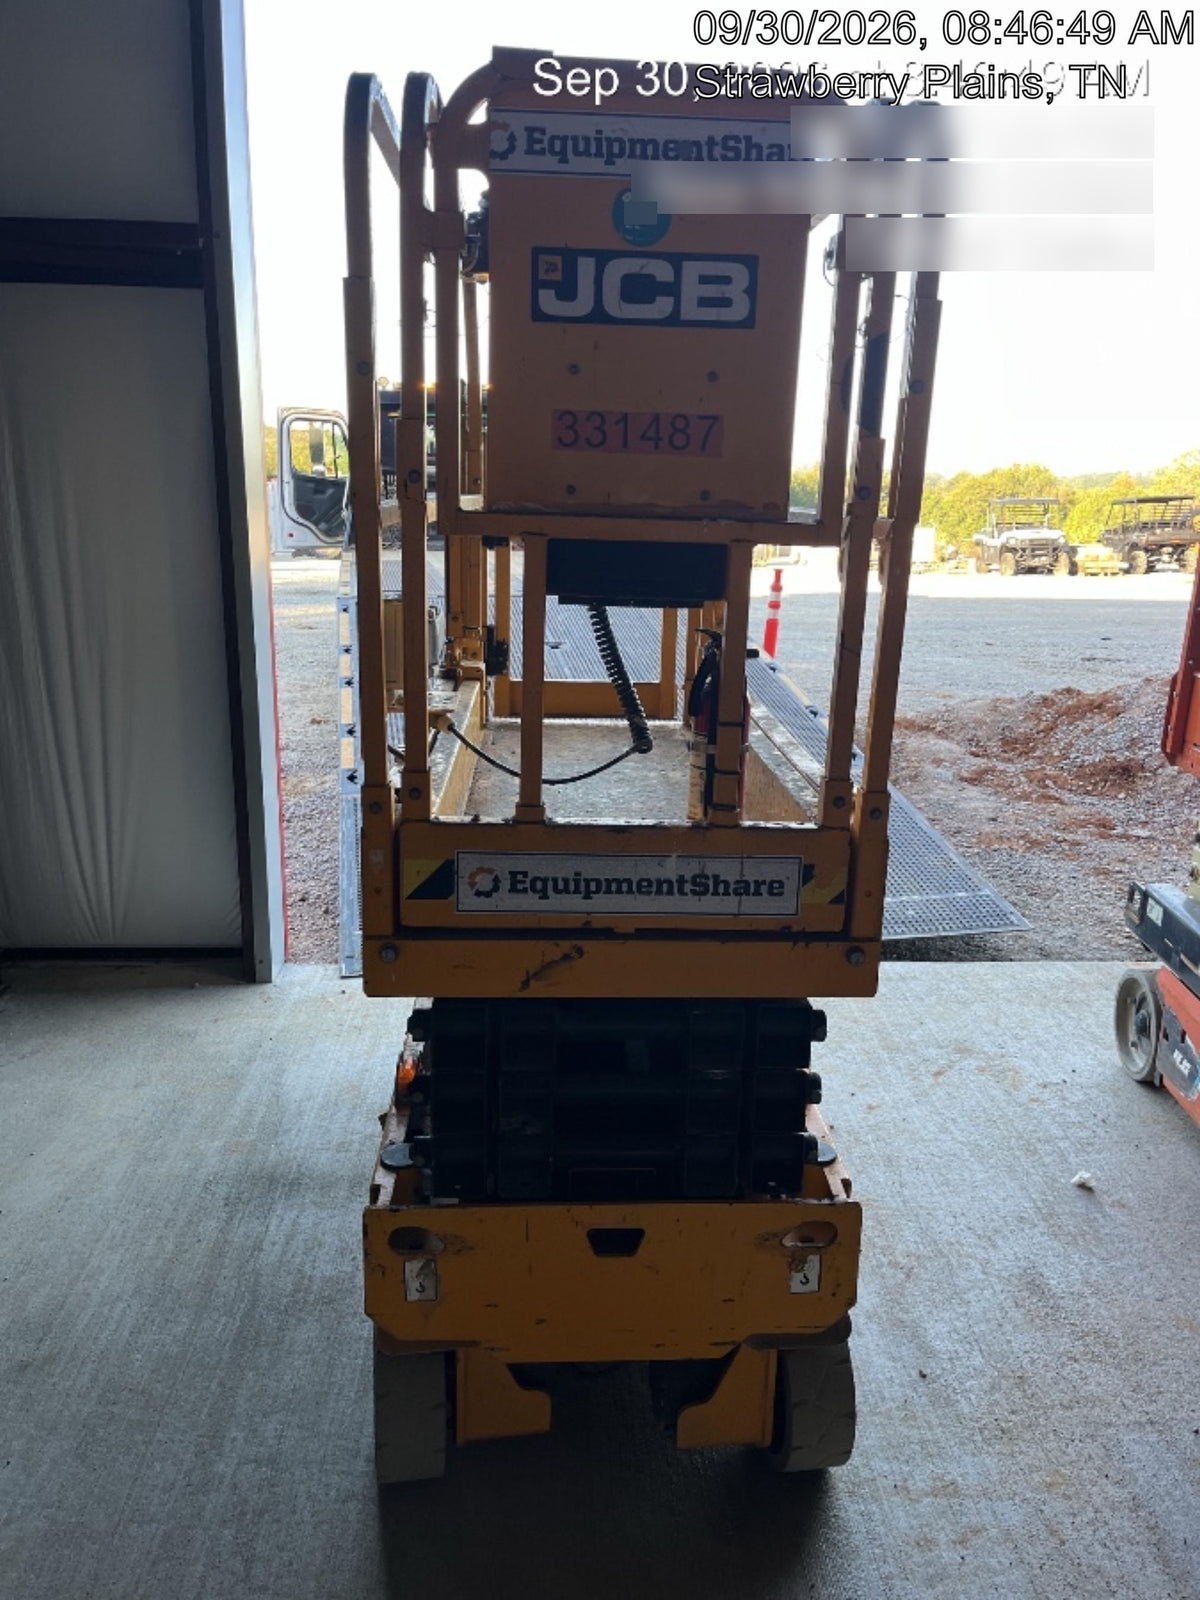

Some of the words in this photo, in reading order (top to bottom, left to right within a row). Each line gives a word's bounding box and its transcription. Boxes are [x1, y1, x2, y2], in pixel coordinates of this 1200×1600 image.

[523, 126, 814, 166] EquipmentSha
[538, 256, 750, 322] JCB
[557, 410, 719, 451] 331487
[508, 870, 785, 898] EquipmentShare
